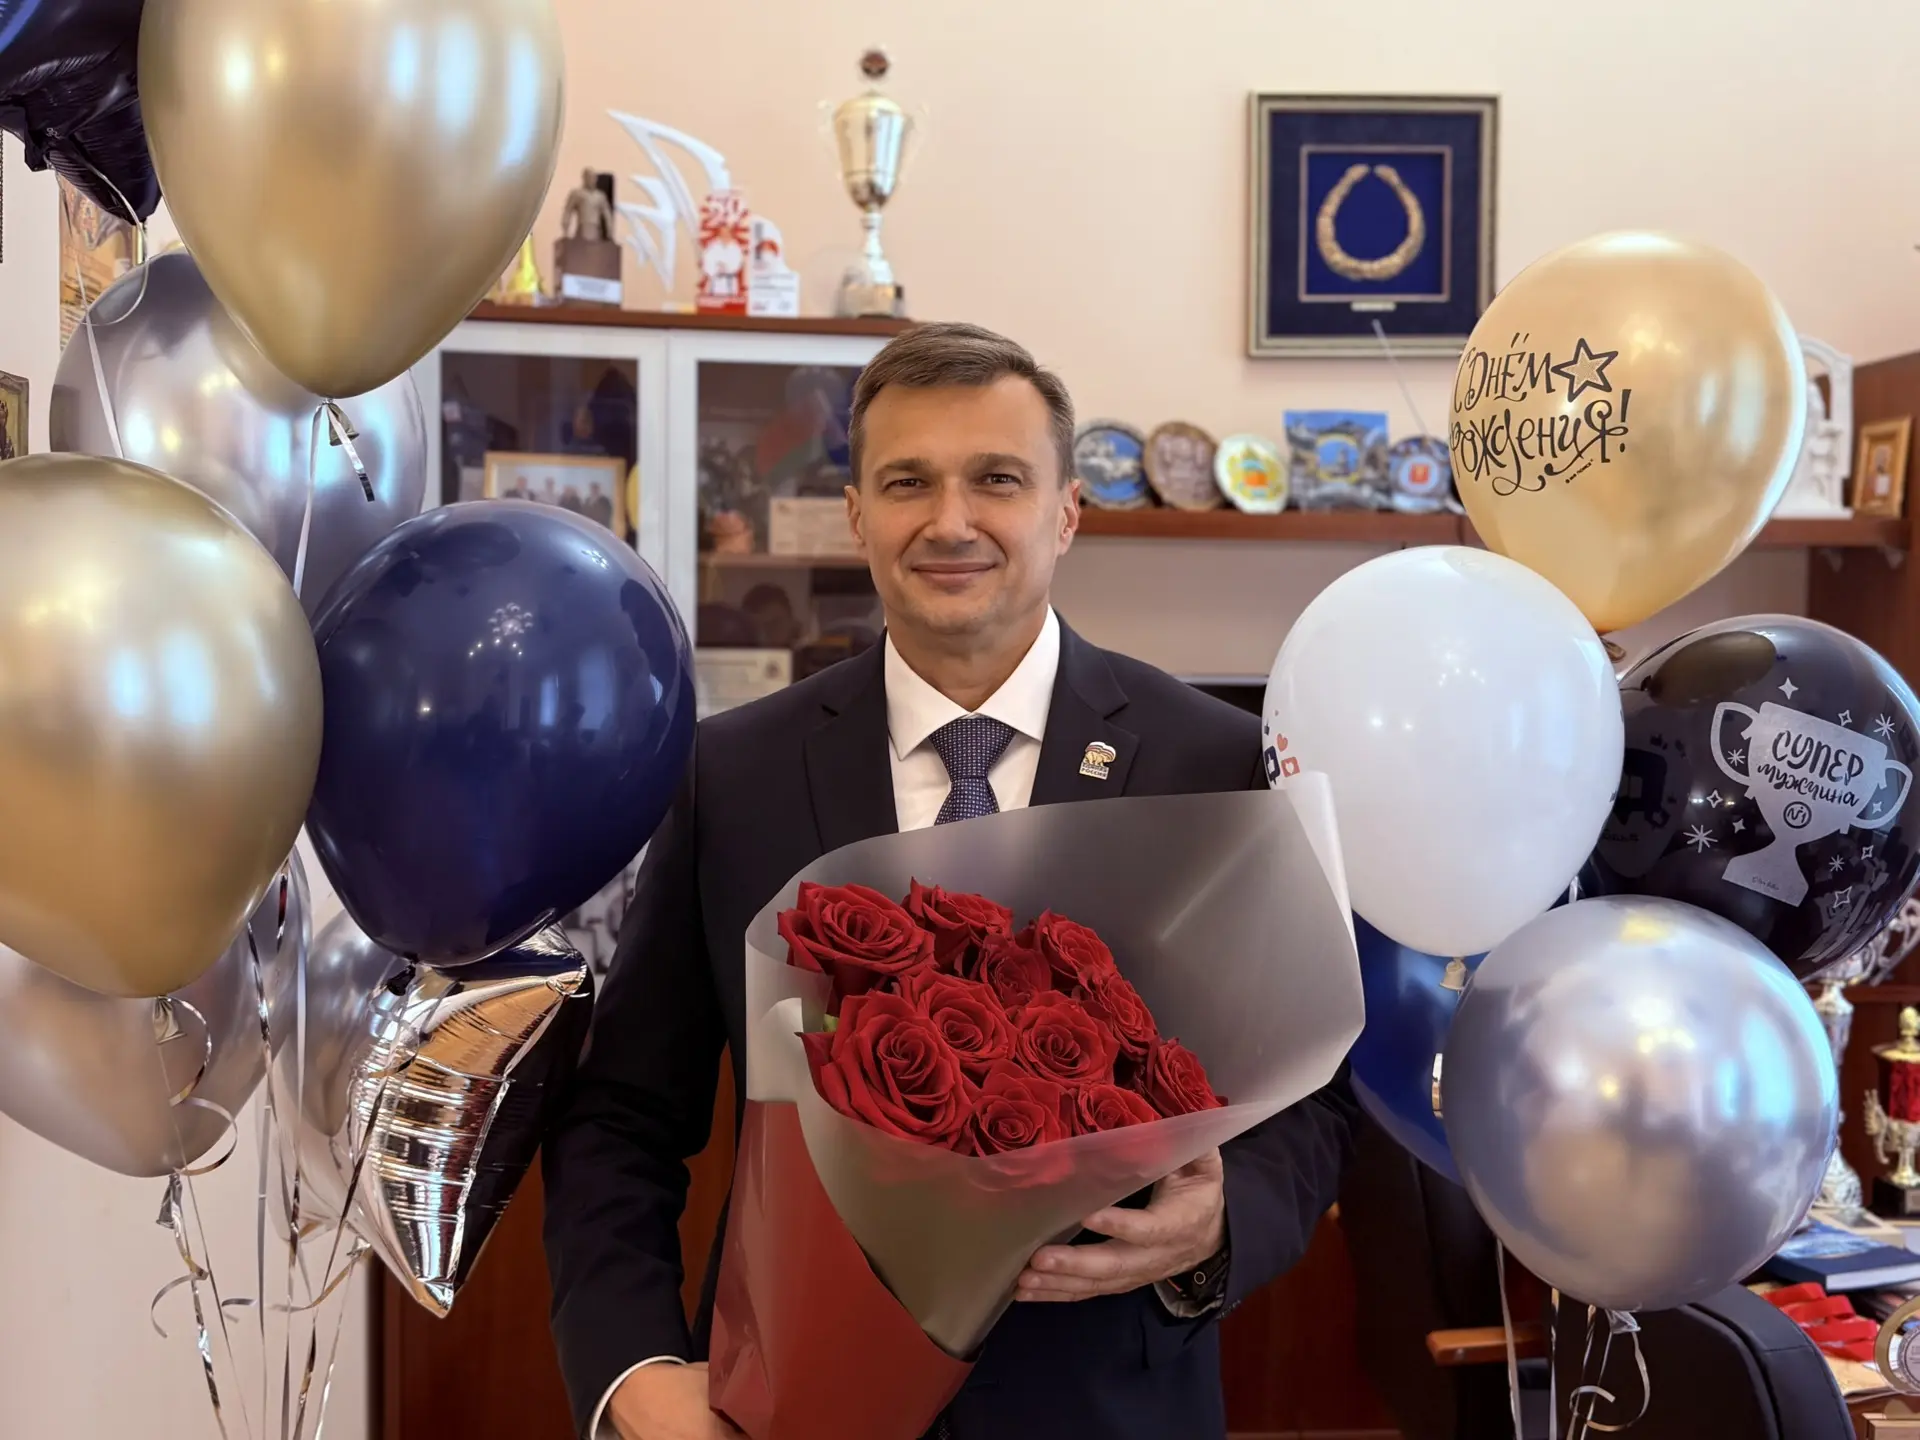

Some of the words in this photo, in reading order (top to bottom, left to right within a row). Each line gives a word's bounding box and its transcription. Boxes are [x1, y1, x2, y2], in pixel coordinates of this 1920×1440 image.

[1453, 346, 1477, 413] С
[1757, 763, 1860, 807] мужчина
[1771, 730, 1864, 786] СУПЕР
